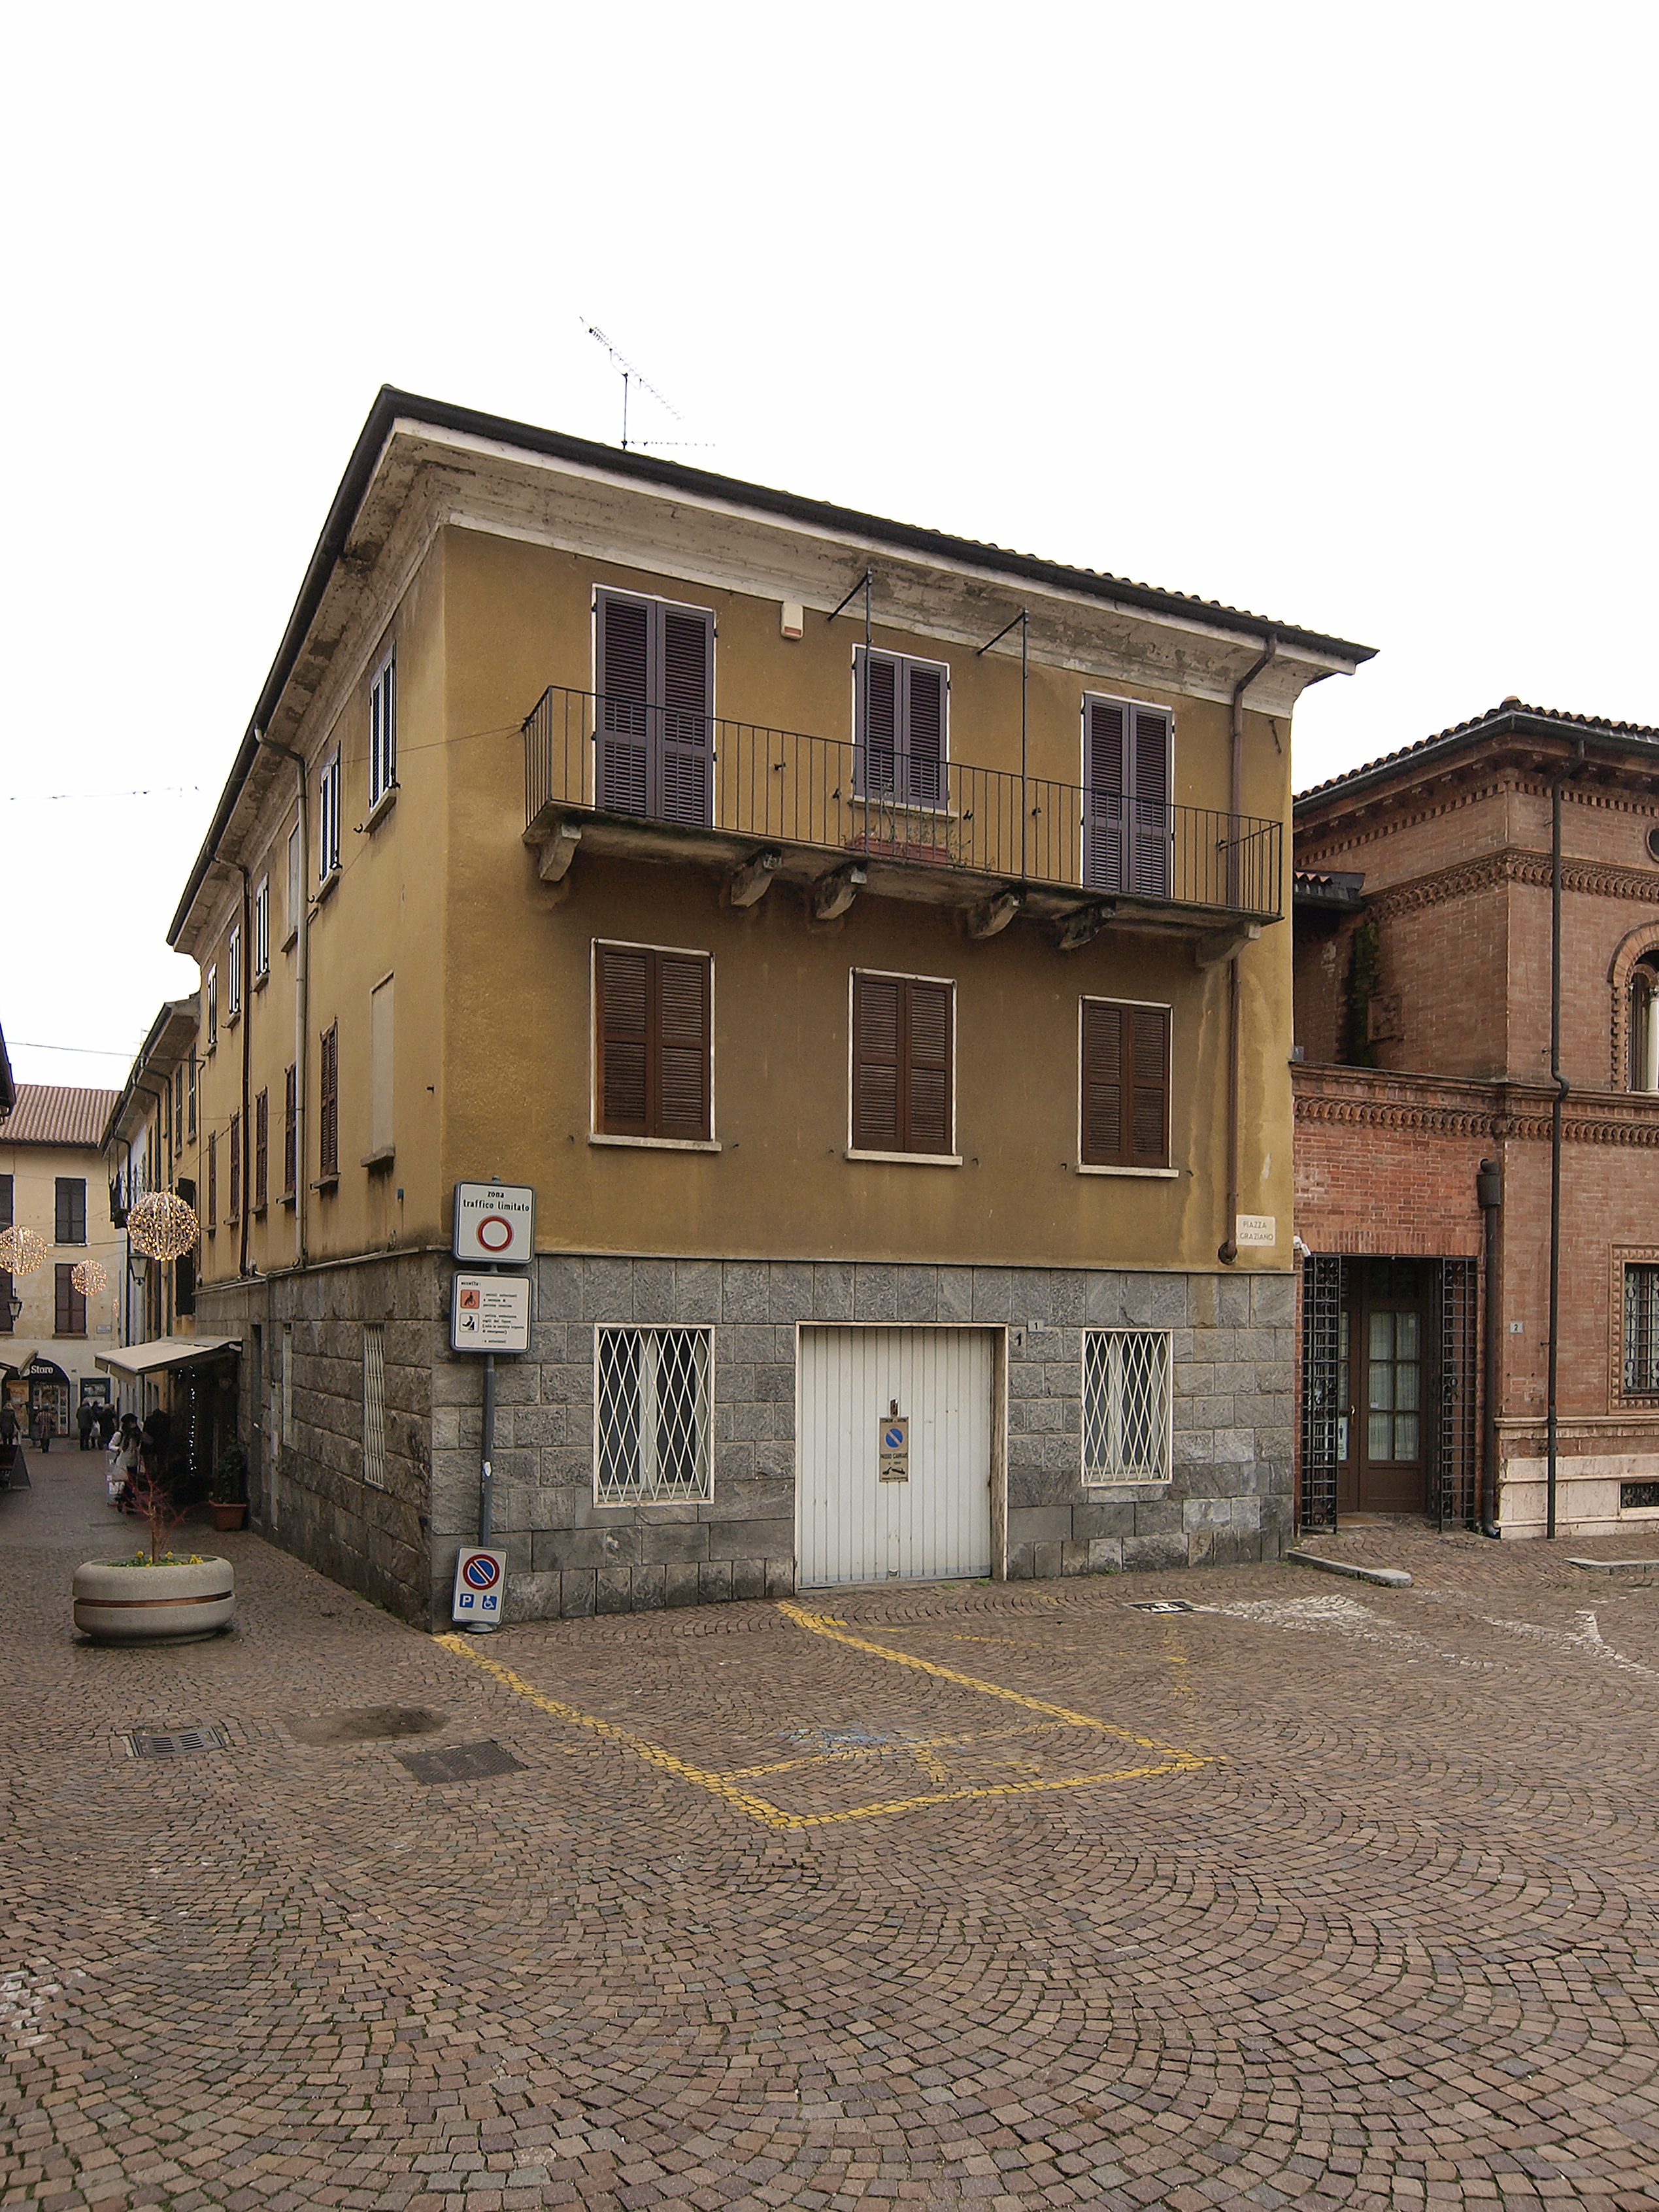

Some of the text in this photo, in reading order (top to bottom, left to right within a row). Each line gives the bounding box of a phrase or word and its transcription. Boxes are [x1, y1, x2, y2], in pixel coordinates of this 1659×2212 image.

[463, 1199, 529, 1211] traffico limitato
[1034, 1322, 1038, 1330] 1
[1016, 1333, 1022, 1347] 1
[31, 1365, 54, 1374] Store
[462, 1595, 472, 1607] P
